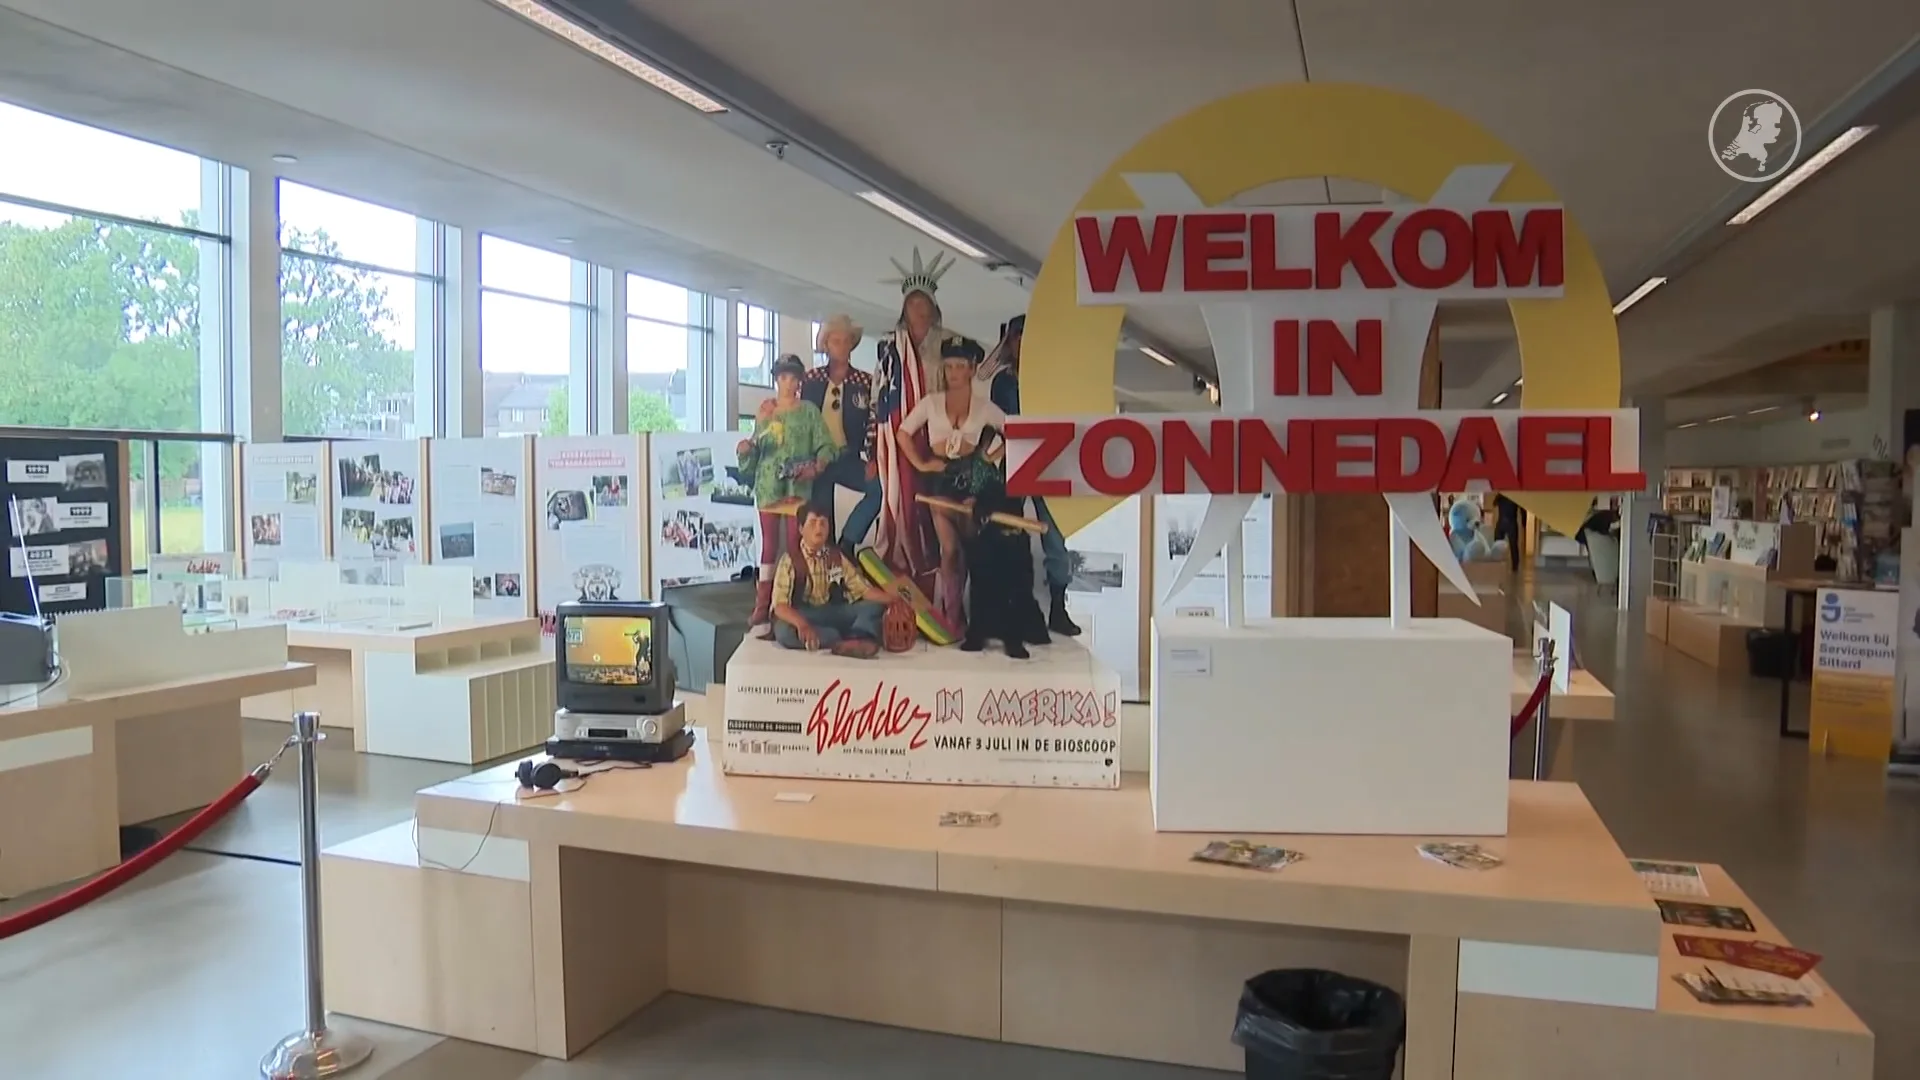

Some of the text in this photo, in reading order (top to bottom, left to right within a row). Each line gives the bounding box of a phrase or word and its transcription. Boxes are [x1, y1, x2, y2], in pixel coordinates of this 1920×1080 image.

[1075, 208, 1564, 293] WELKOM
[1273, 319, 1382, 396] IN
[1004, 416, 1647, 496] ZONNEDAEL
[1819, 643, 1895, 659] Servicepunt
[1820, 629, 1890, 646] Welkom bij
[1819, 656, 1862, 670] Sittard
[807, 679, 1117, 756] Flodder IN AMERIKA!
[934, 736, 1117, 753] VANAF 3 JULI IN DE BIOSCOOP
